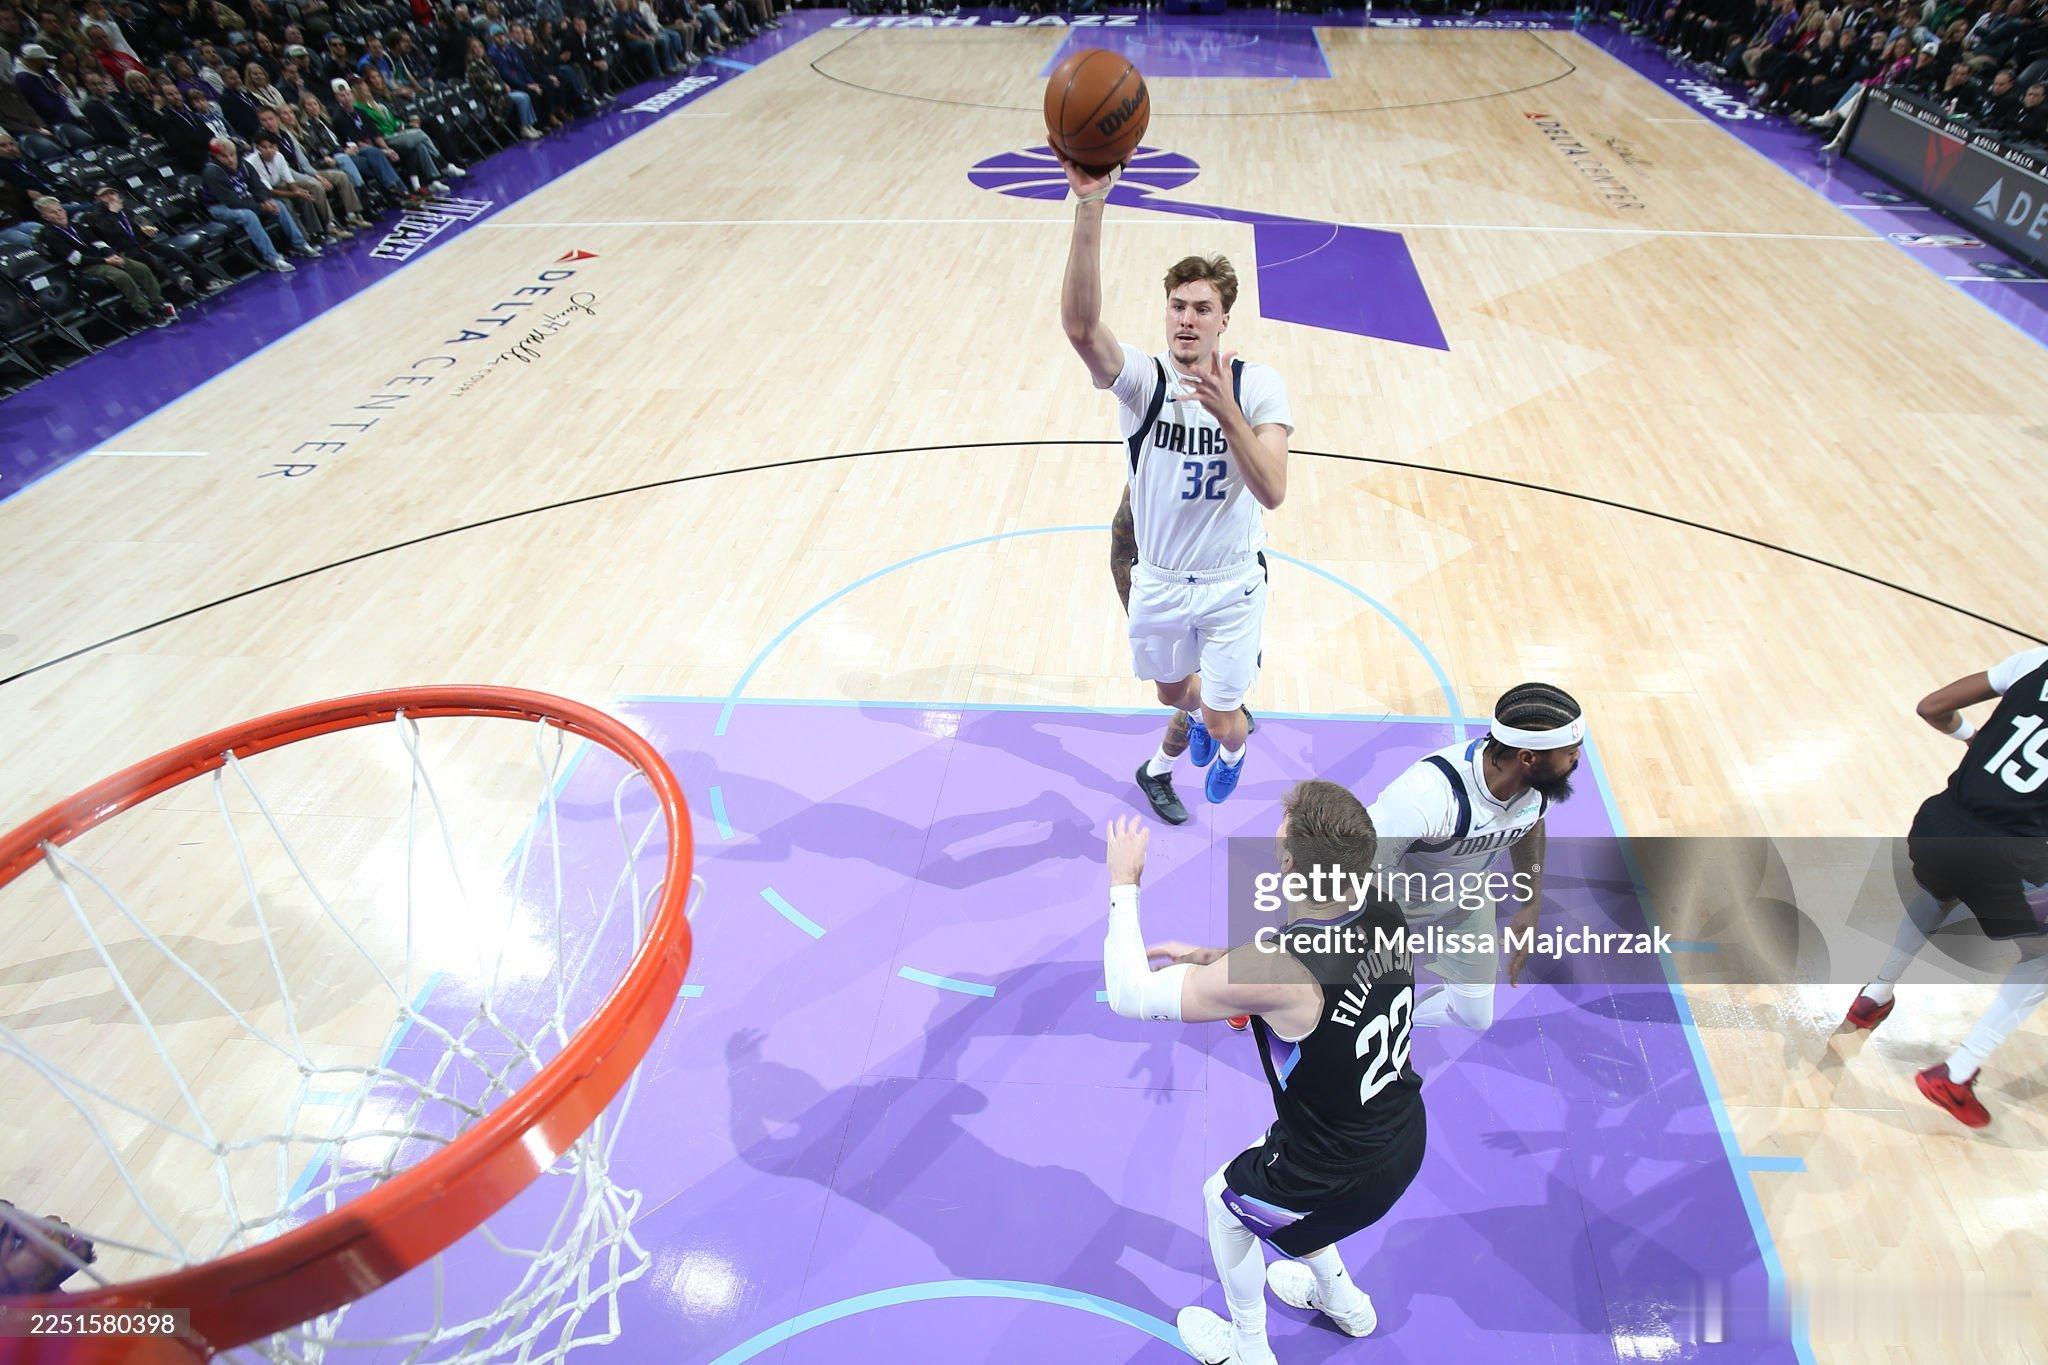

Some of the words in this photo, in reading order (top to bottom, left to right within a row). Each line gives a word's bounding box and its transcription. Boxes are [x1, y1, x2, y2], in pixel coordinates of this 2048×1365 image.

[830, 15, 980, 28] UTAH
[990, 15, 1139, 28] JAZZ
[1096, 80, 1148, 136] Wilson
[1535, 121, 1590, 156] DELTA
[1572, 159, 1646, 209] CENTER
[1979, 137, 2001, 153] DELTA
[2011, 151, 2035, 170] DELTA
[444, 270, 576, 344] DELTA
[257, 356, 456, 479] CENTER
[1181, 459, 1227, 500] 32
[1355, 986, 1413, 1106] 22
